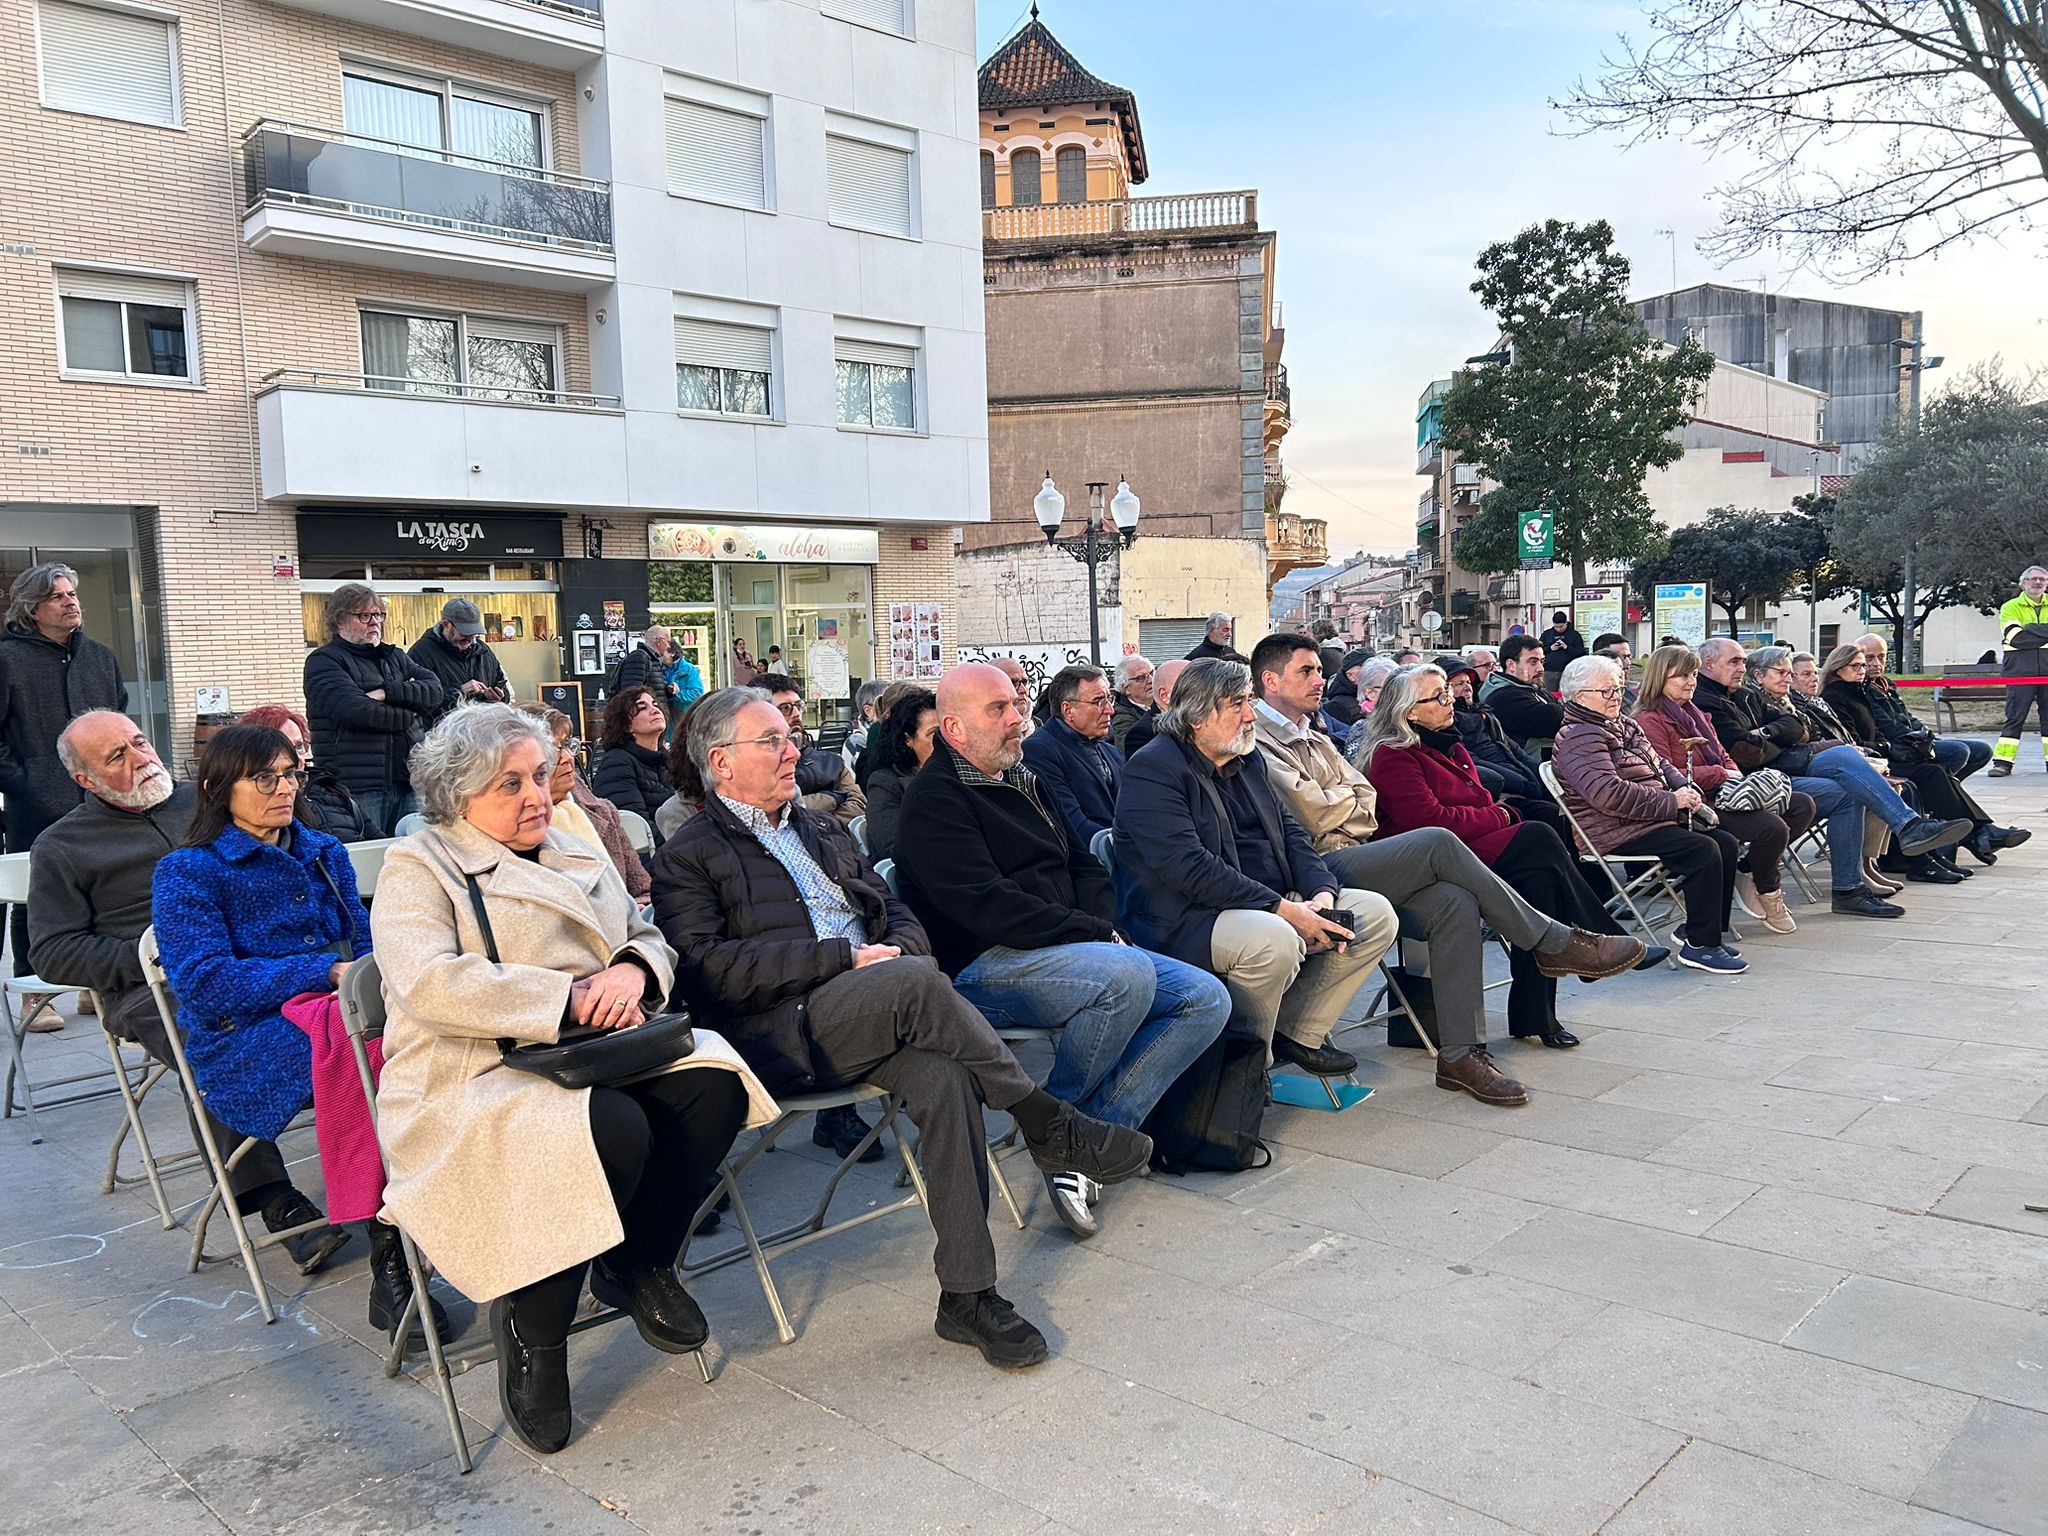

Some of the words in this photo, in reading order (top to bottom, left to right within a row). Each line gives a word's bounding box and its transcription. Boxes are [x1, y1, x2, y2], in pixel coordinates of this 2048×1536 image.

[397, 521, 423, 538] LA
[425, 522, 485, 539] TASCA
[778, 532, 827, 559] aloha
